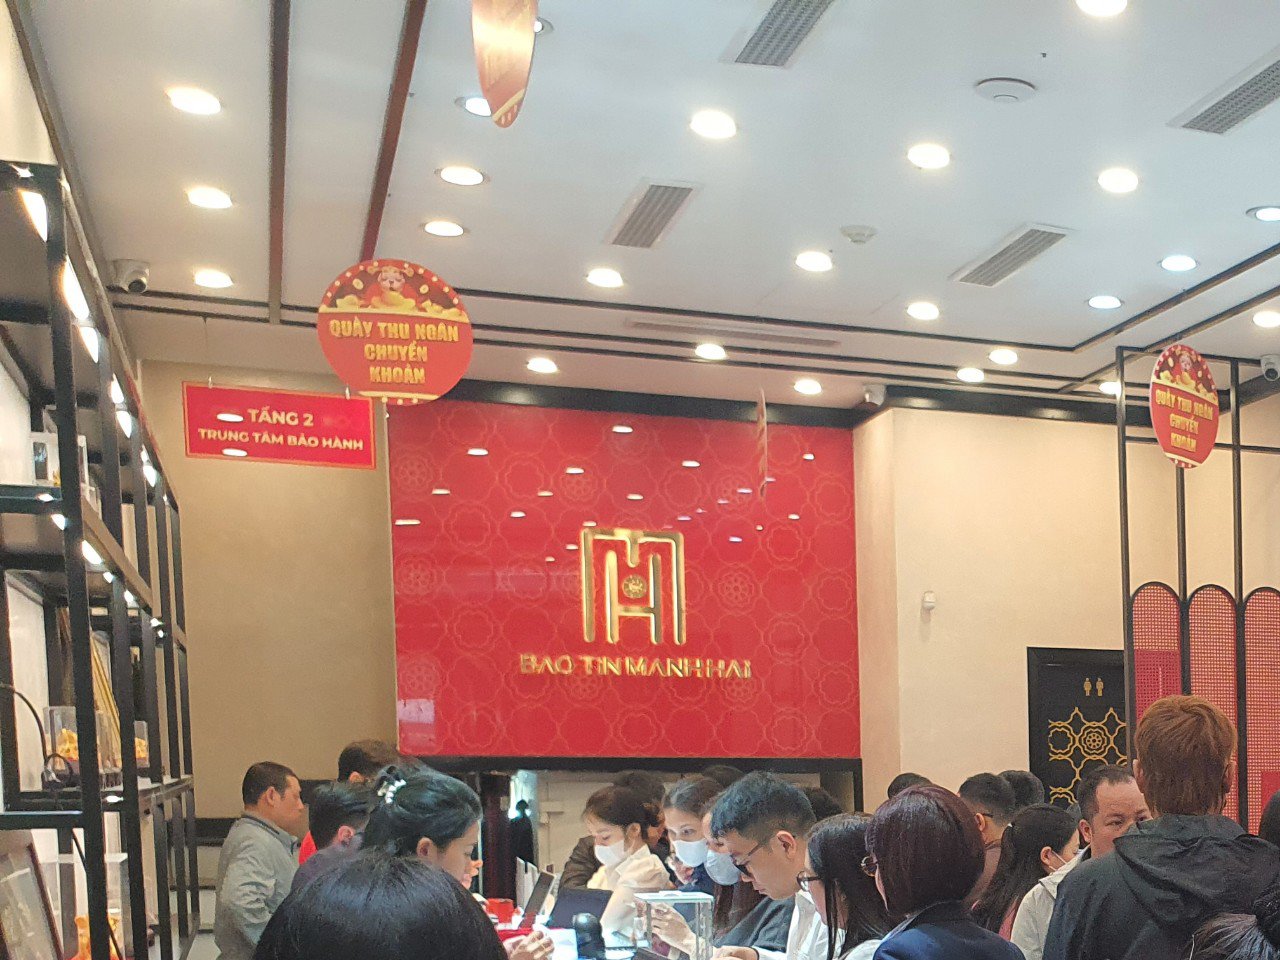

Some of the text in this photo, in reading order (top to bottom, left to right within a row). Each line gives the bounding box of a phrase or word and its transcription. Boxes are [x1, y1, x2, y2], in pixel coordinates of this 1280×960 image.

[377, 321, 410, 339] THU
[415, 321, 459, 342] NGÂN
[370, 363, 425, 384] KHOẢN
[302, 413, 314, 427] 2
[198, 428, 363, 451] TRUNG TÂM BẢO HÀNH
